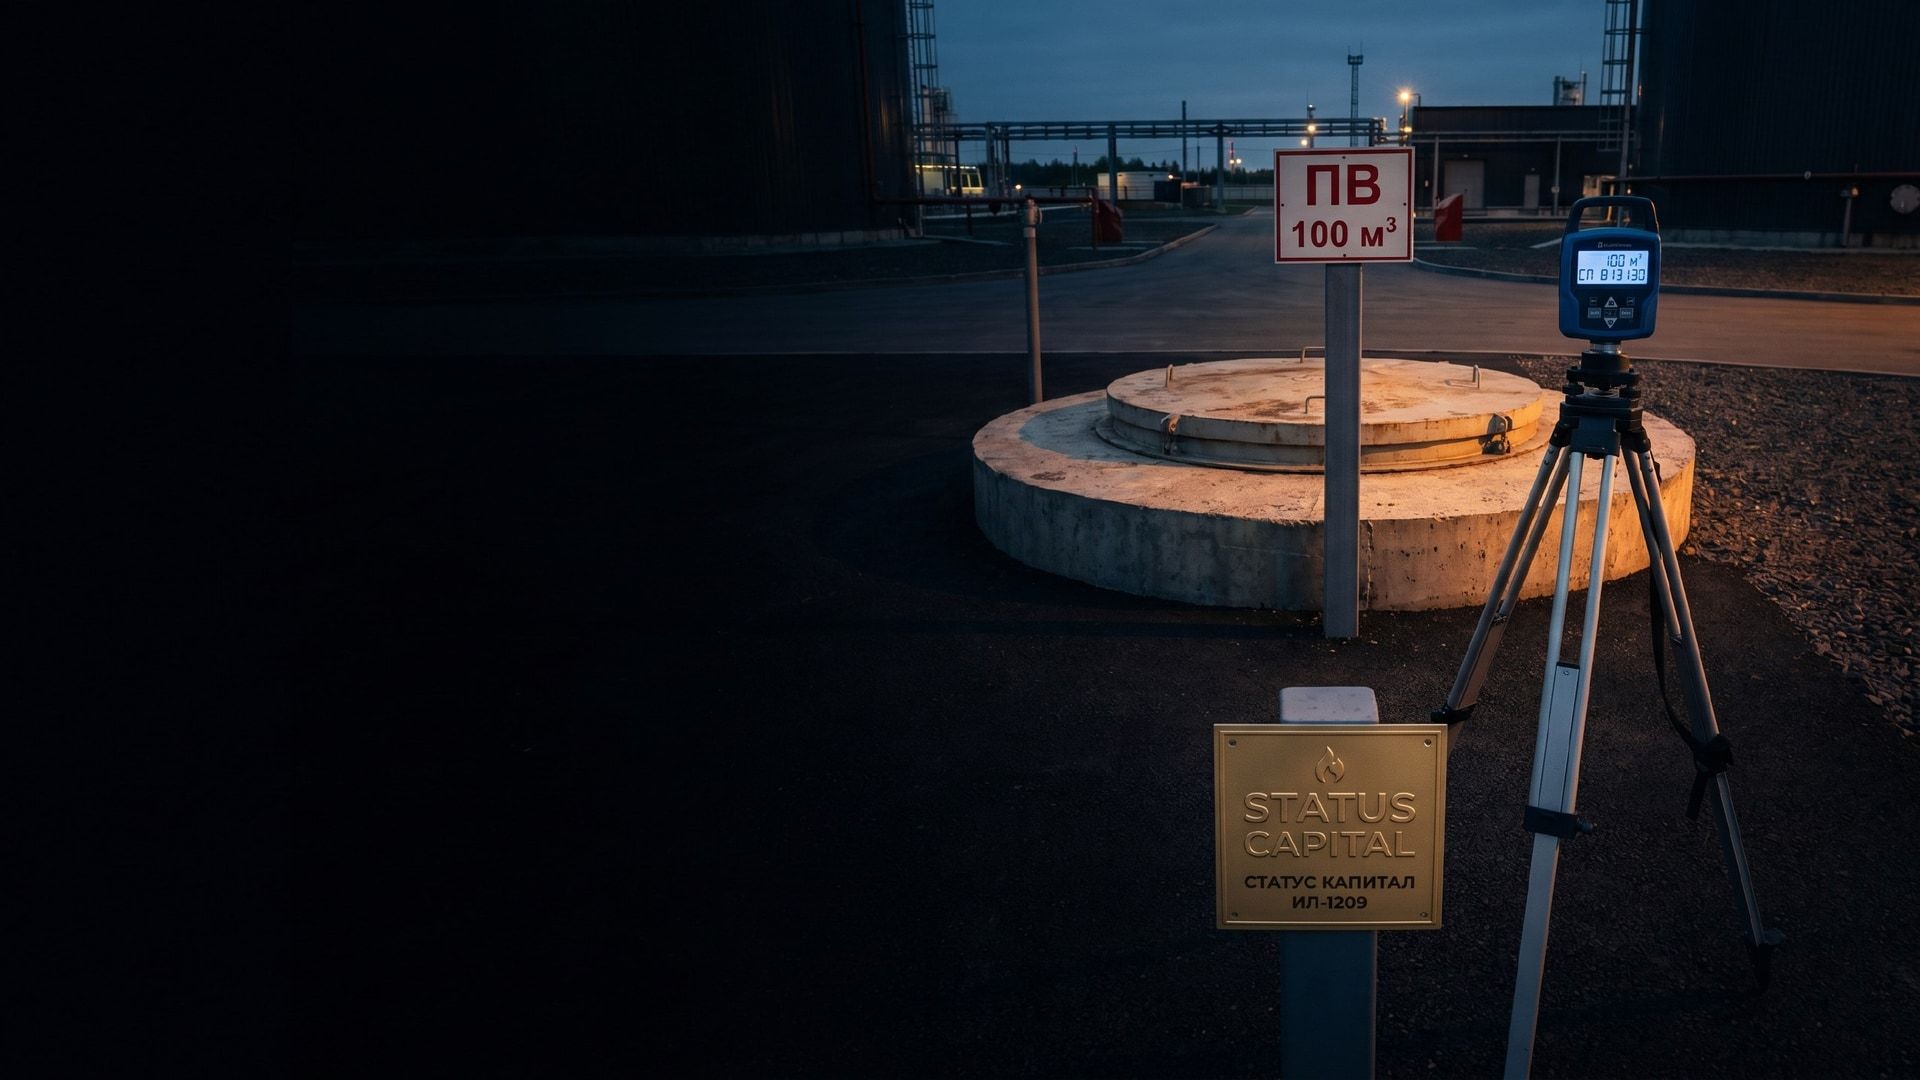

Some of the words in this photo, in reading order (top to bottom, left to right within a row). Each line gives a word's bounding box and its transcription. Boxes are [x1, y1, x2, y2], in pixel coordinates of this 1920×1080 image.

[1306, 164, 1381, 206] ПВ
[1292, 220, 1349, 248] 100
[1607, 254, 1625, 267] 100
[1244, 792, 1416, 823] STATUS
[1244, 831, 1416, 857] CAPITAL
[1244, 875, 1317, 890] СТАТУС
[1322, 875, 1415, 890] КАПИТАЛ
[1292, 895, 1368, 910] ИЛ-1209
